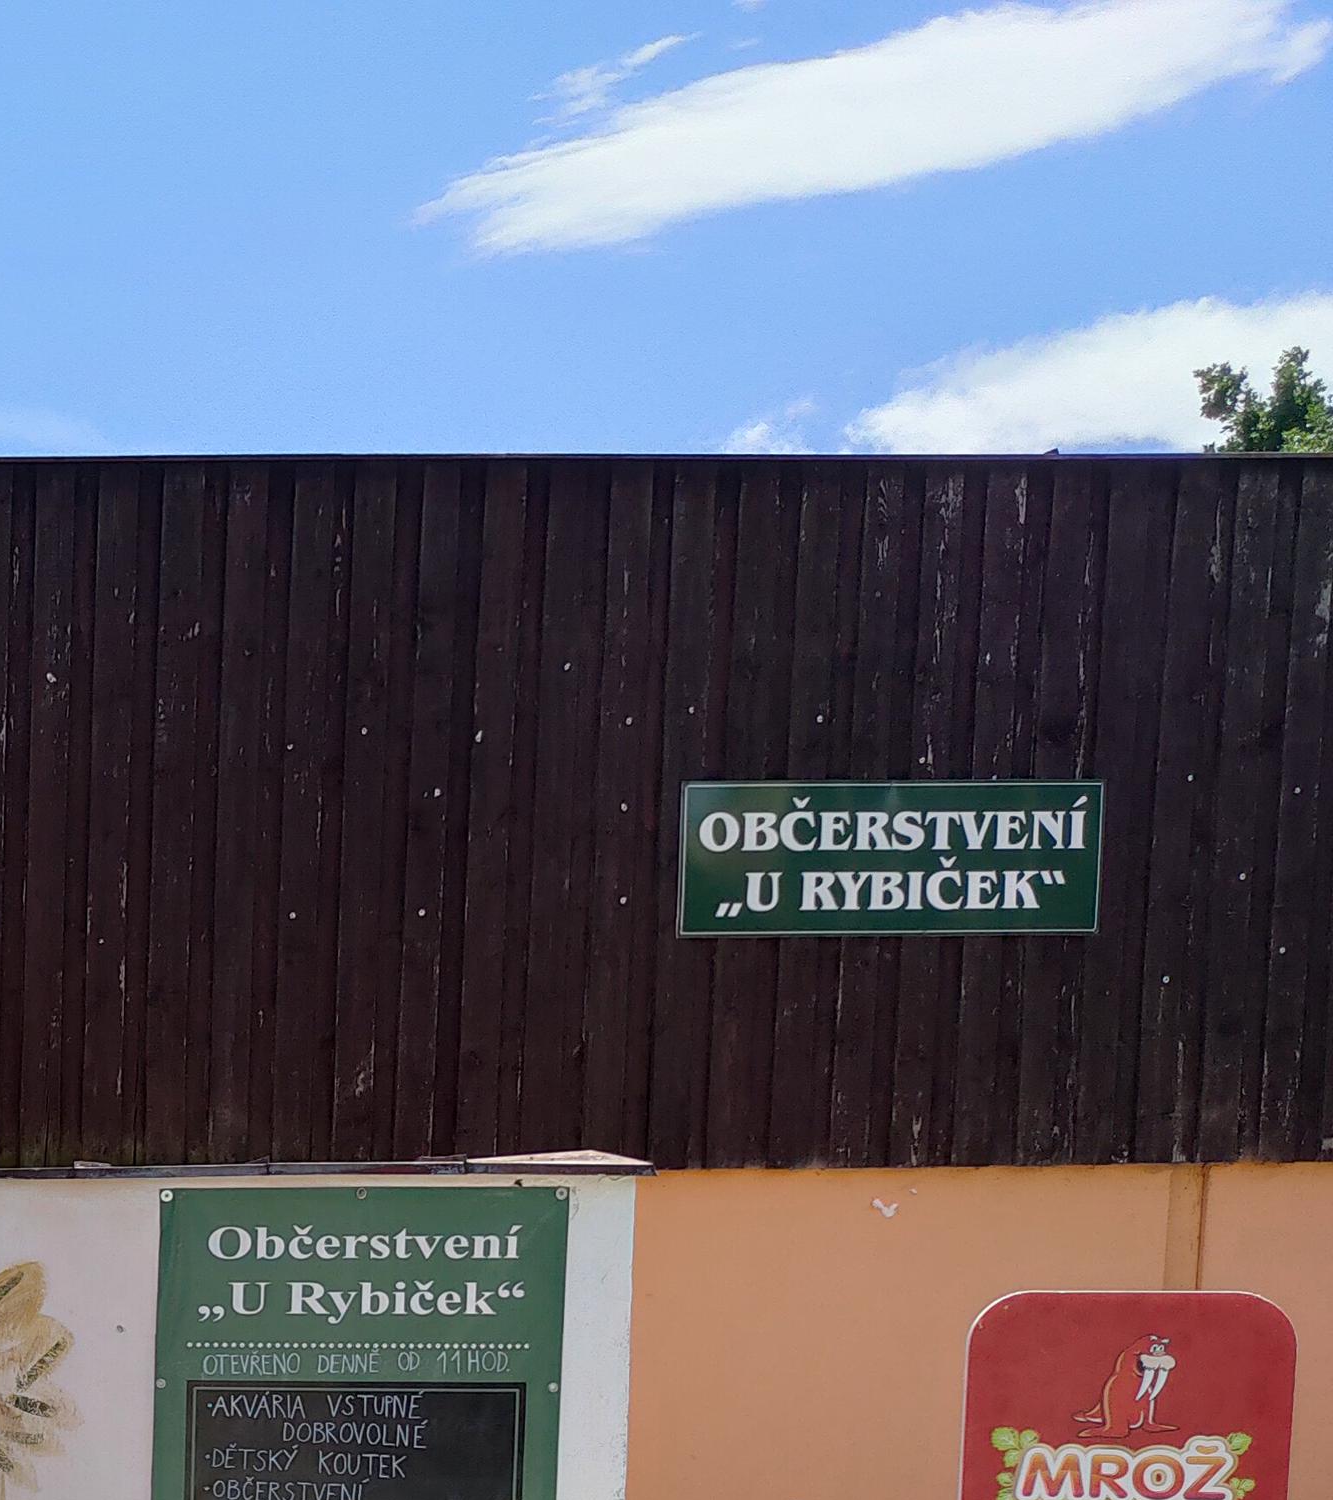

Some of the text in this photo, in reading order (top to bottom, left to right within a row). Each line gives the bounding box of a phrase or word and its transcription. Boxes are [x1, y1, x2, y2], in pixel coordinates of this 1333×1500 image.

[699, 795, 1088, 852] OBČERSTVENÍ
[207, 1224, 523, 1261] Občerstvení
[202, 1350, 301, 1377] OTEVŘENO
[317, 1348, 381, 1376] DENNĚ
[397, 1350, 421, 1372] OD
[211, 1390, 425, 1420] AKVÁRIA VSTUPNÉ
[282, 1419, 429, 1449] DOBROVOLNÉ
[211, 1443, 408, 1478] DĚTSKÝ KOUTEK
